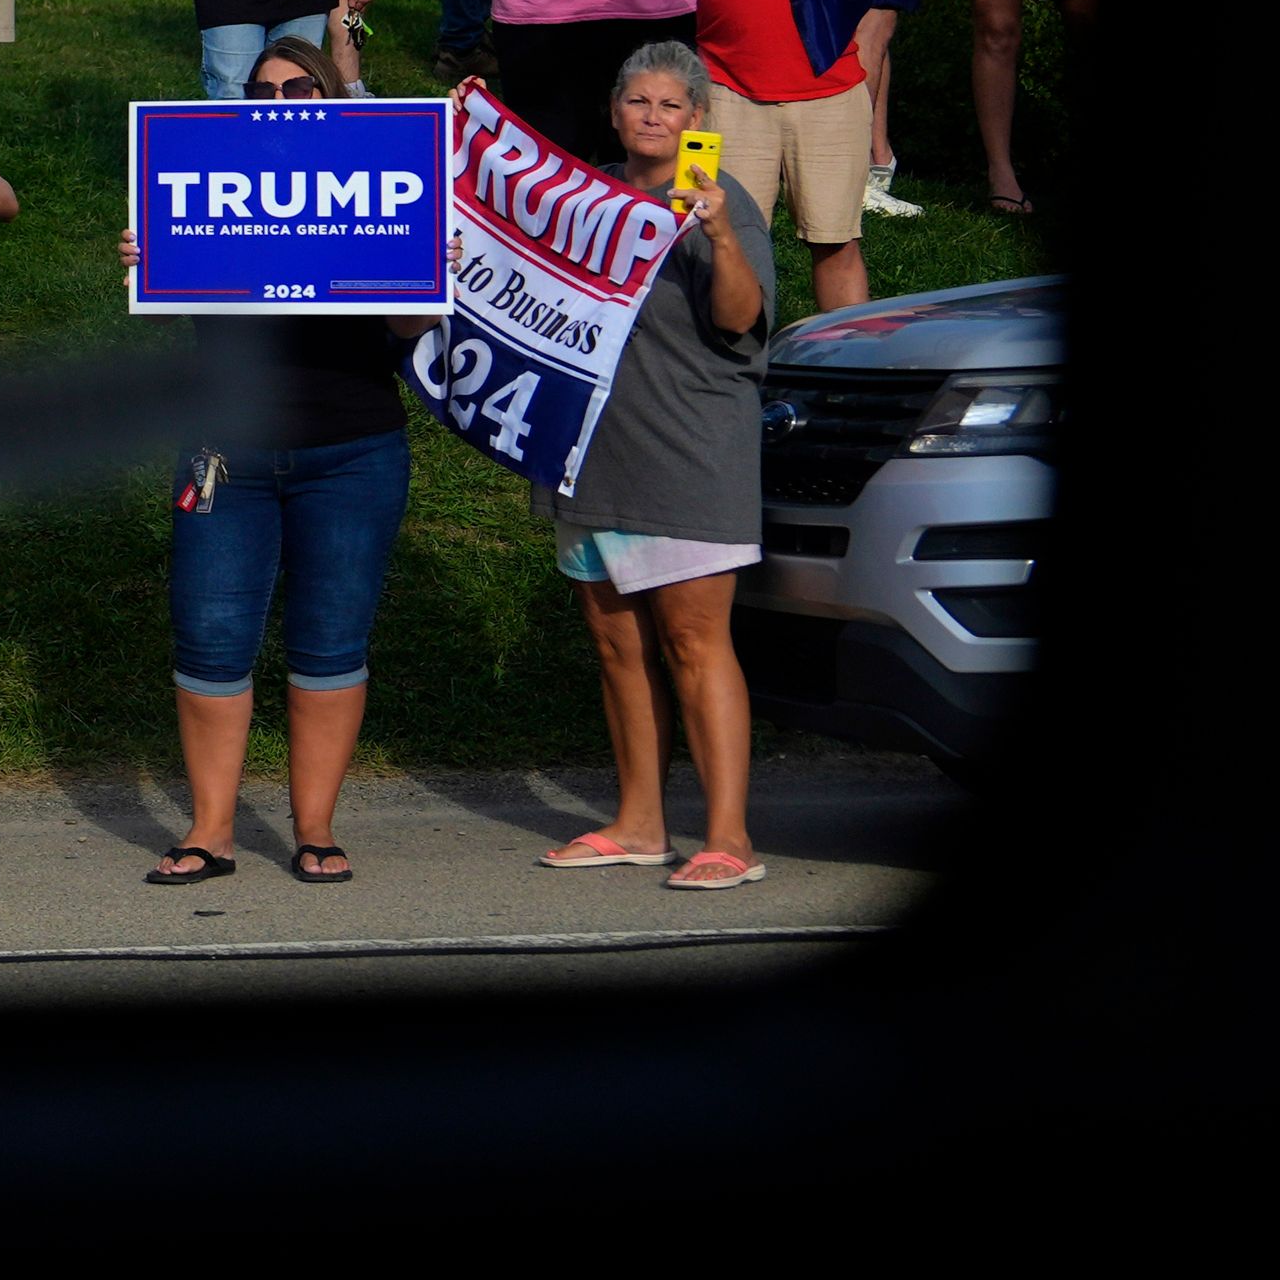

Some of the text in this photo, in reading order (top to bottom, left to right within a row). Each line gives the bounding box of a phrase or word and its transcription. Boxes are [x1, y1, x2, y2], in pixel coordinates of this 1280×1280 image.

[158, 171, 424, 218] TRUMP
[453, 89, 678, 286] TRUMP
[171, 224, 410, 235] MAKE AMERICA GREAT AGAIN!
[263, 284, 316, 298] 2024
[457, 252, 603, 355] to Business
[413, 314, 541, 462] 024
